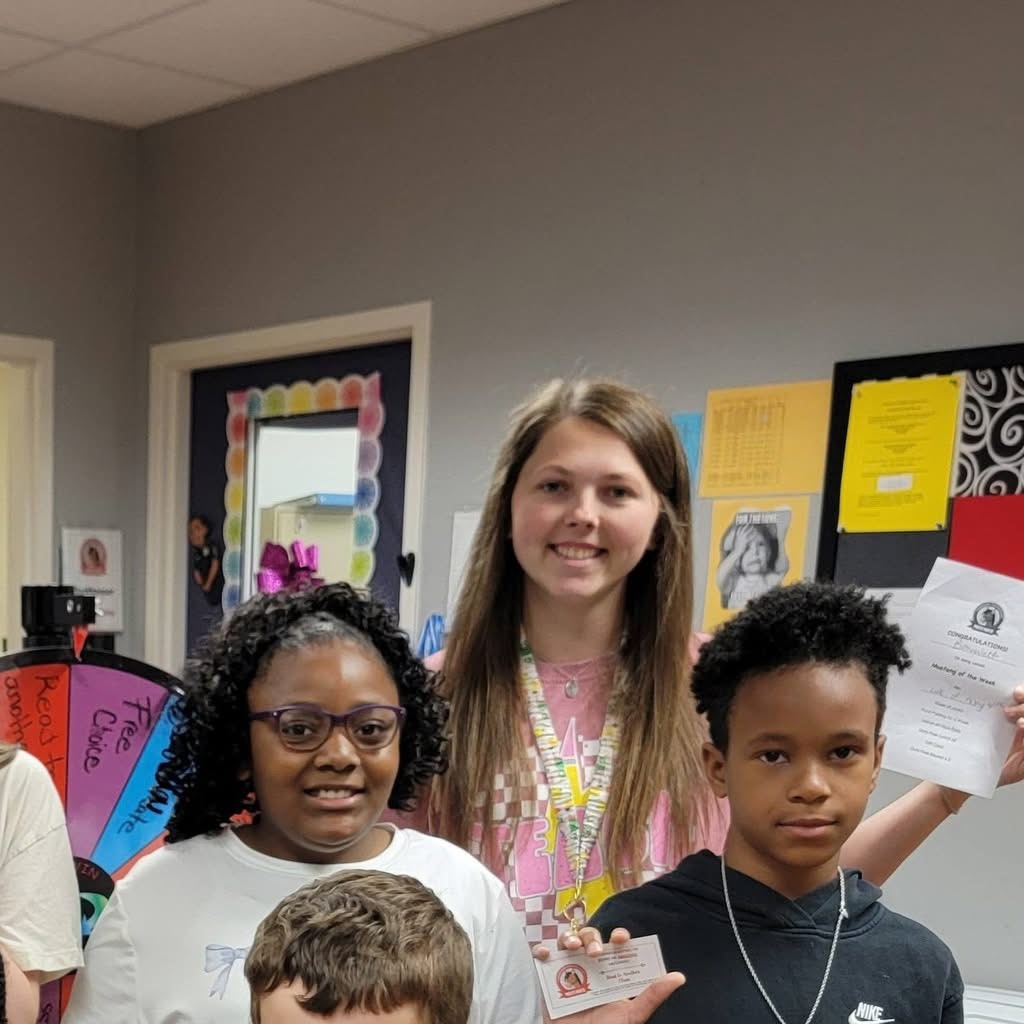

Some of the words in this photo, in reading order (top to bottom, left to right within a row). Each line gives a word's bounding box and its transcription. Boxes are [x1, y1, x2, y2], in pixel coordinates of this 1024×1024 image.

[84, 709, 116, 774] Choice
[116, 697, 151, 755] Free
[856, 1002, 884, 1020] NIKE
